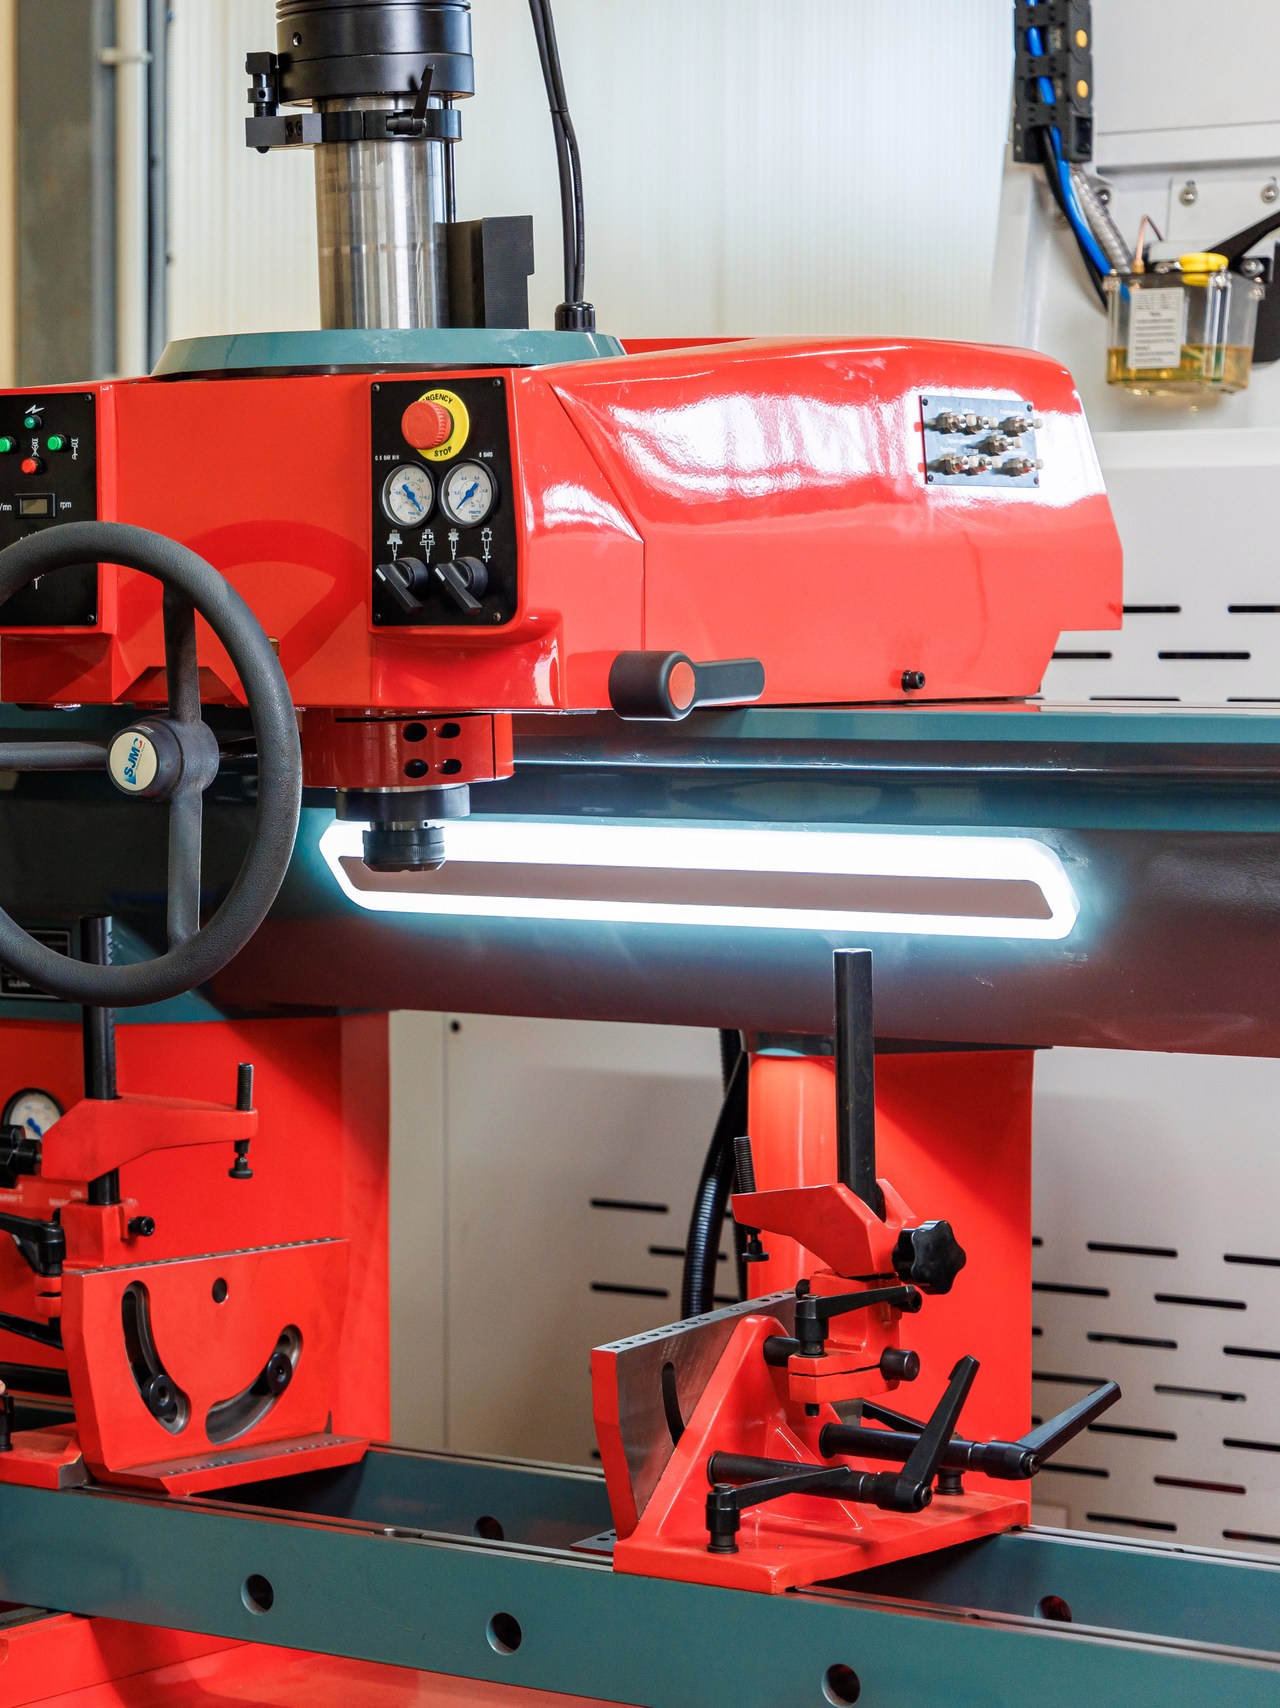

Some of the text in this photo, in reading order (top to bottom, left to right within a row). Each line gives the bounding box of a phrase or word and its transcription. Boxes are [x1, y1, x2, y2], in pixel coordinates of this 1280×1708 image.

[422, 393, 454, 404] RGENCY
[434, 445, 453, 457] STOP
[60, 501, 72, 510] rpm
[124, 737, 143, 778] SJMC
